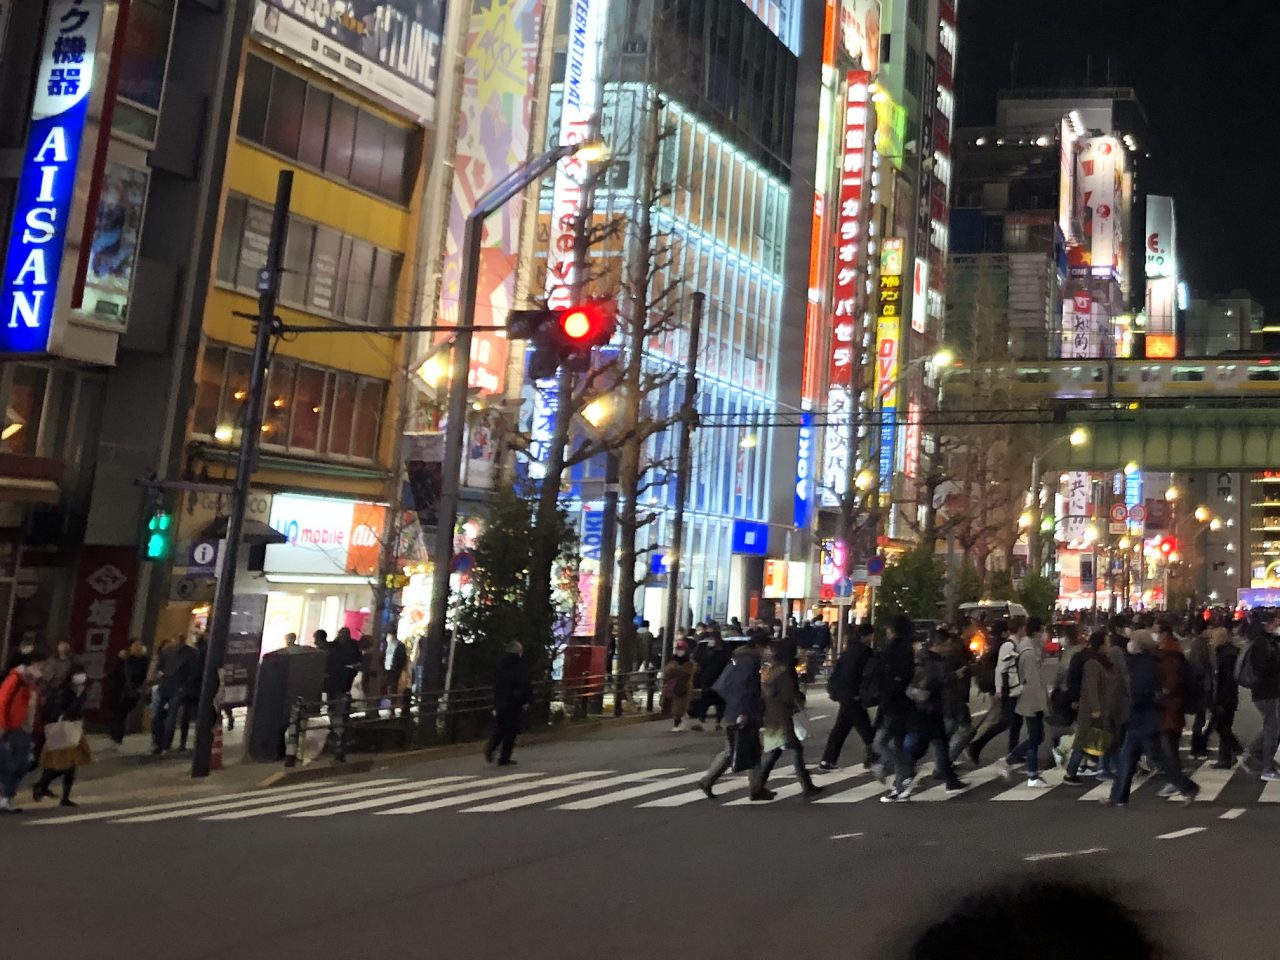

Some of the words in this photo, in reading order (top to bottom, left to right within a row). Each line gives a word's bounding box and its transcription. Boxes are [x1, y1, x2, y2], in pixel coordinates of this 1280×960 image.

[7, 125, 69, 329] AISAN
[838, 199, 861, 287] カラオケ
[834, 299, 856, 369] パセラ
[883, 305, 895, 317] CD
[300, 523, 344, 545] mobile
